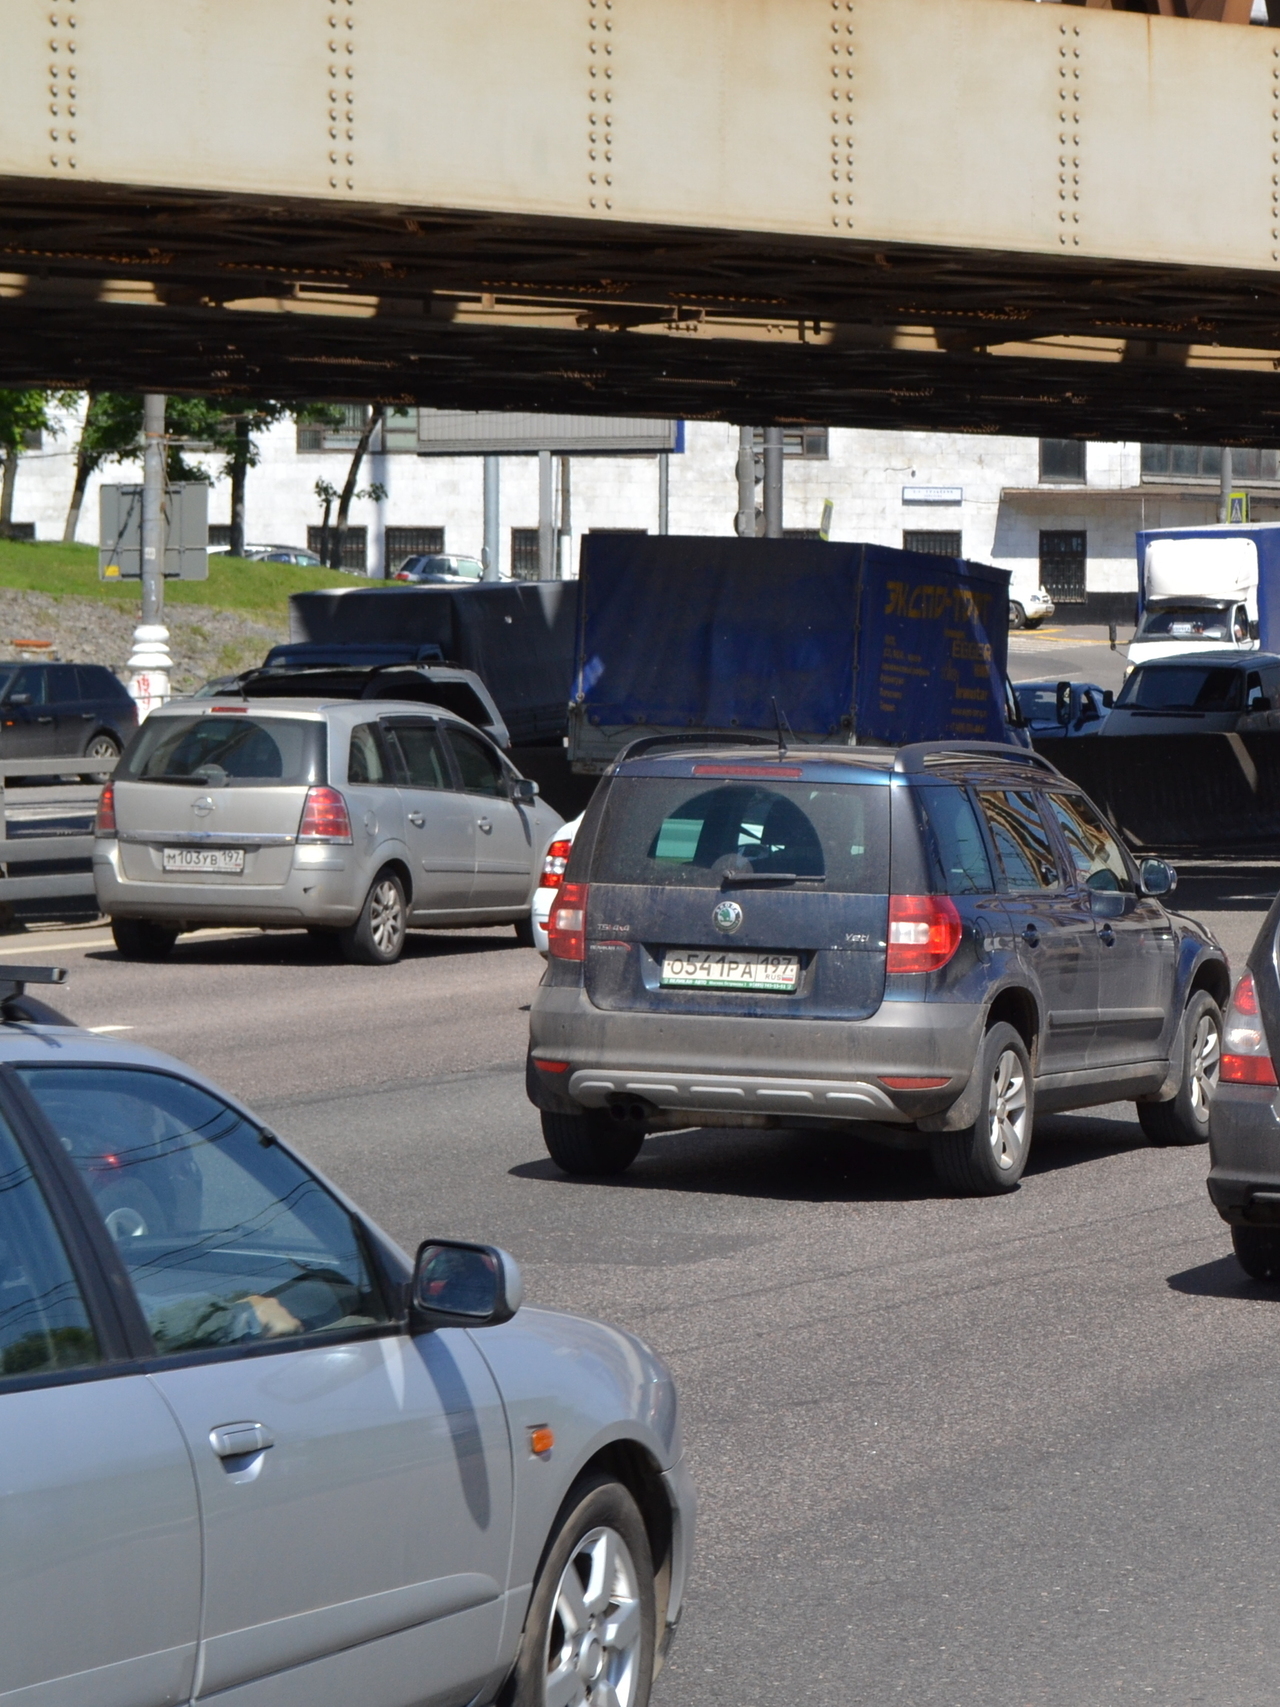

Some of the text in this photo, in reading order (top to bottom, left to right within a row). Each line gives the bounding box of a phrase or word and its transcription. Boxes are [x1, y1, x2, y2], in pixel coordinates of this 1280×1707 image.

[168, 850, 240, 865] М103УВ 197
[670, 953, 792, 979] О541РА 197
